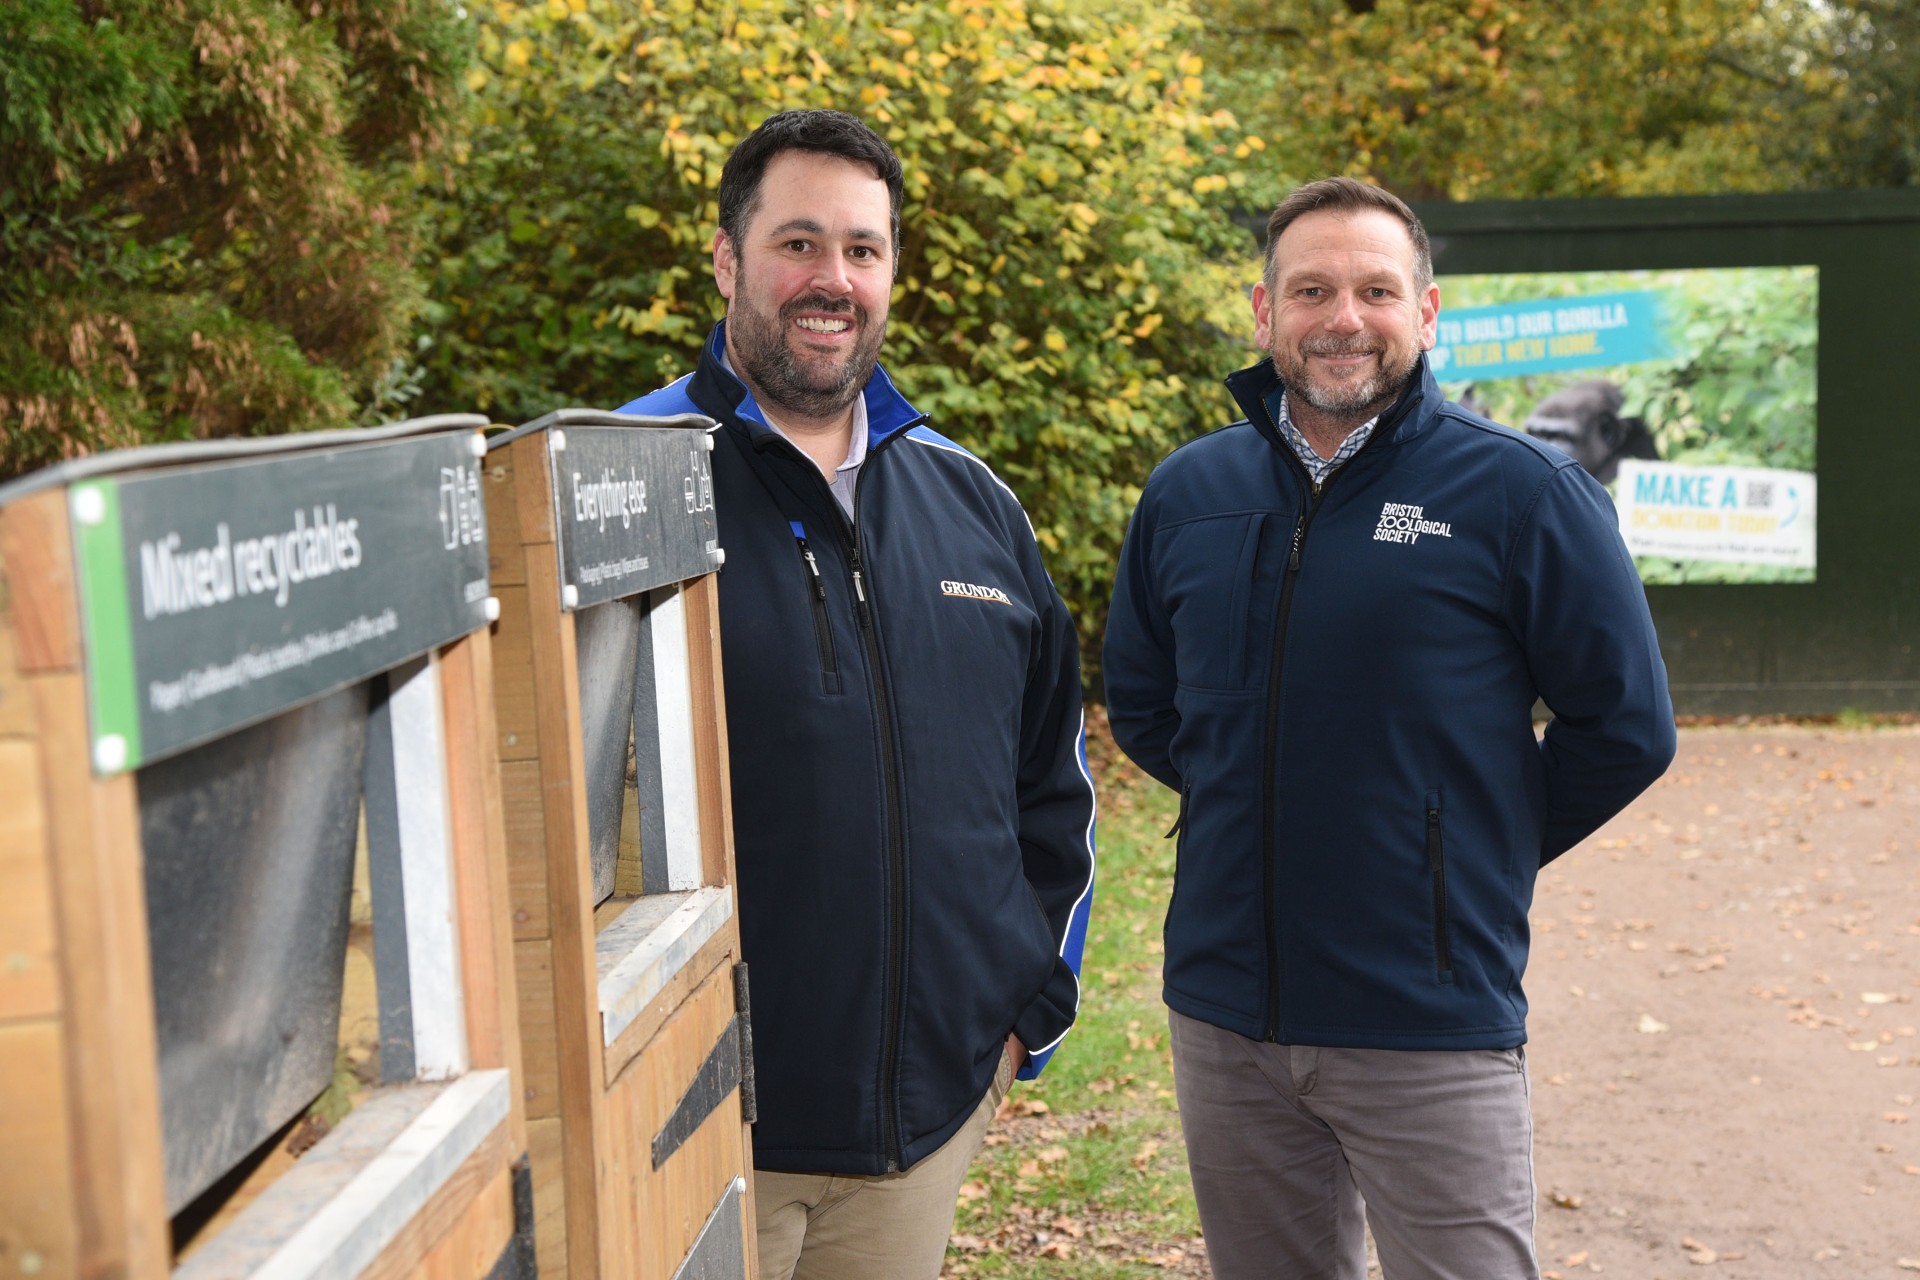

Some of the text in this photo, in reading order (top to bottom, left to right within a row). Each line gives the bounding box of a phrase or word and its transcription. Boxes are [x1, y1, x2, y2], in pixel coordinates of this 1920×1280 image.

[573, 466, 647, 533] Everything else
[1635, 473, 1738, 509] MAKE A
[1381, 502, 1424, 519] BRISTOL
[1373, 528, 1419, 545] SOCIETY
[1377, 515, 1452, 537] ZOOLOGICAL
[141, 502, 362, 621] Mixed recyclables
